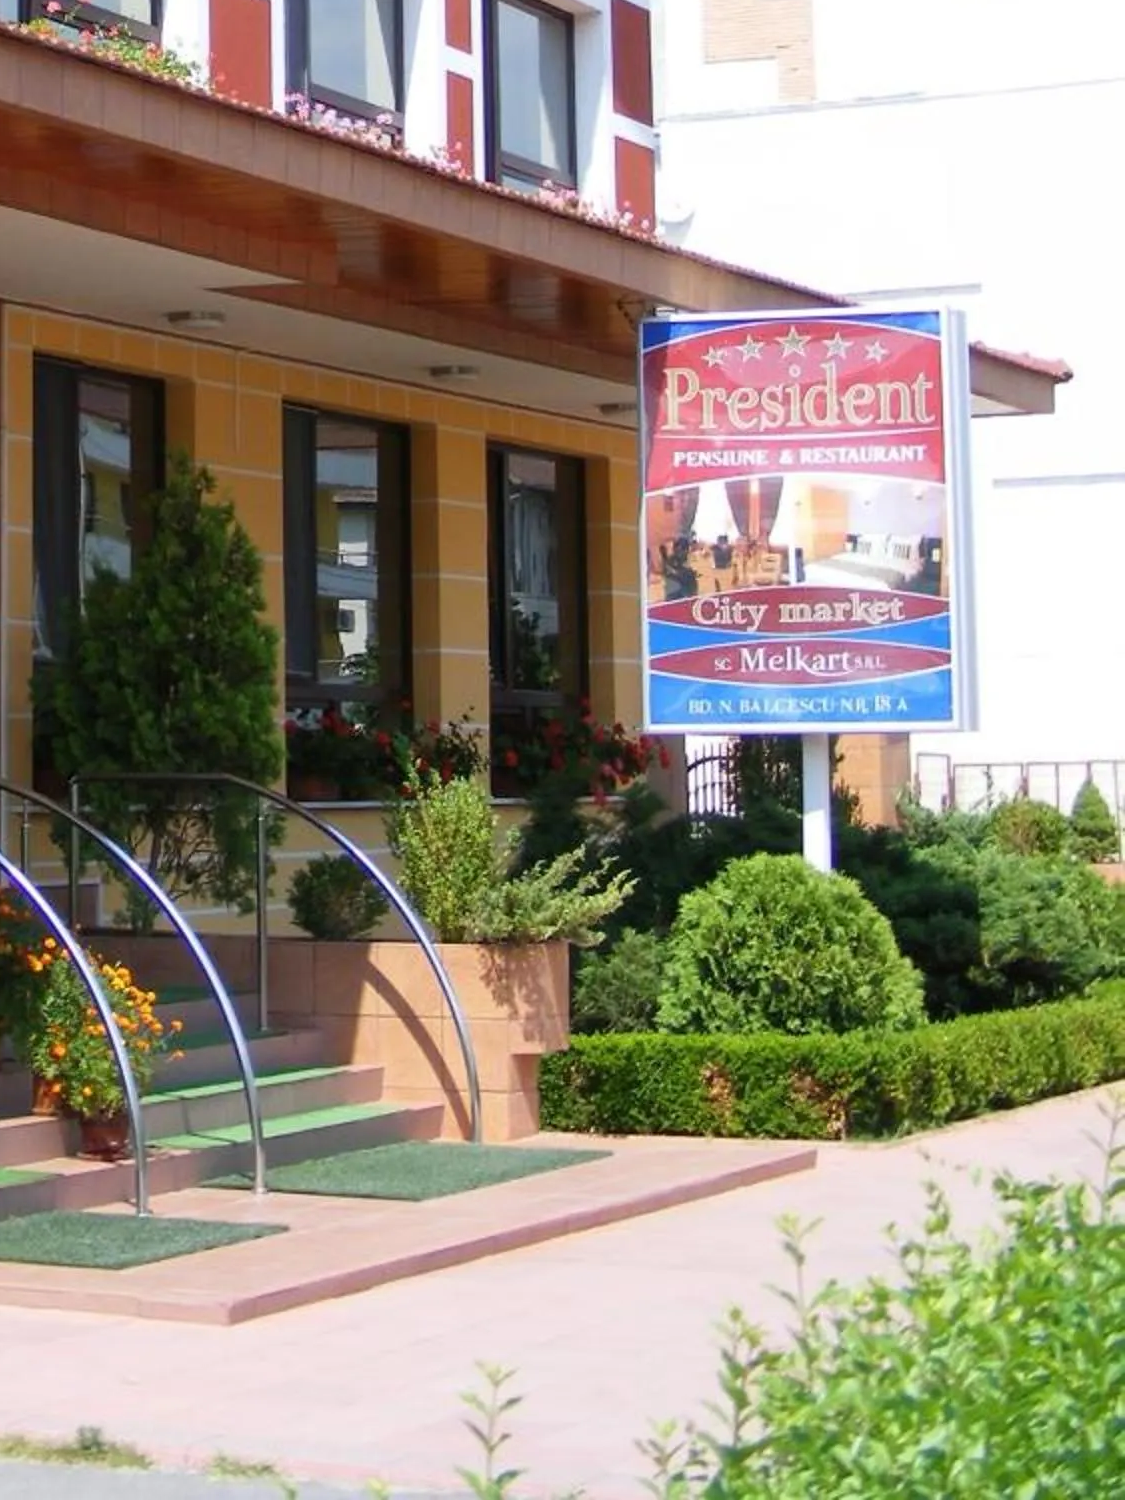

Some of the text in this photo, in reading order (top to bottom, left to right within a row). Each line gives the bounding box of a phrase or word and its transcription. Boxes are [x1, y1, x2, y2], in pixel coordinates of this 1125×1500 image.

[660, 361, 936, 432] President
[673, 444, 927, 468] PENSIUNE & RESTAURANT
[691, 592, 905, 632] City market
[739, 646, 854, 677] Melkart
